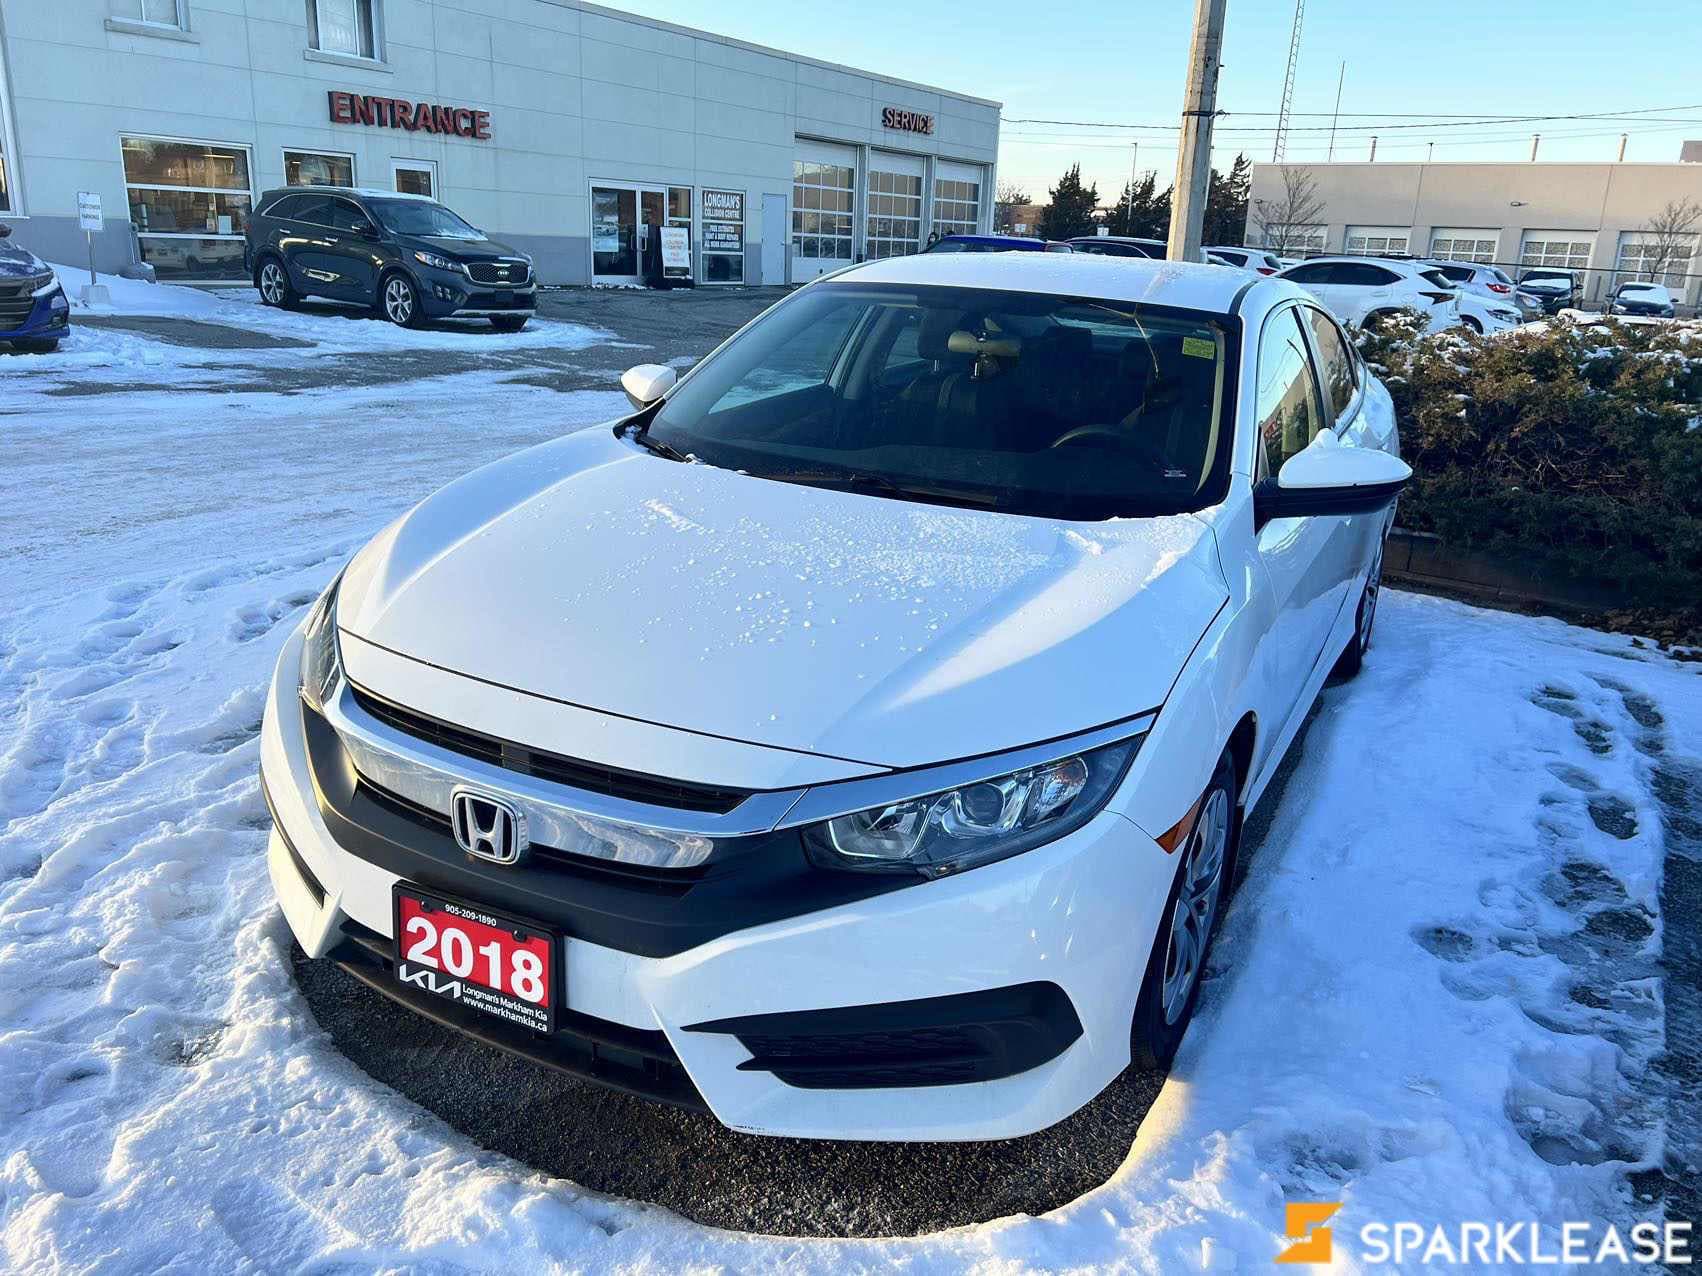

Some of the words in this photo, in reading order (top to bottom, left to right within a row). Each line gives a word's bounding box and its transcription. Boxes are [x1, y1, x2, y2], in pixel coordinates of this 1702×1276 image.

[328, 91, 491, 139] ENTRANCE
[882, 107, 934, 135] SERVICE
[704, 192, 740, 209] LONGMAN'S
[704, 208, 725, 218] COLLISION
[445, 904, 497, 926] 905-209-1890
[406, 916, 544, 1003] 2018
[462, 983, 499, 1005] Longman's
[500, 996, 534, 1017] Markham
[535, 1008, 548, 1022] Kia
[463, 996, 548, 1032] www.markhamkia.ca
